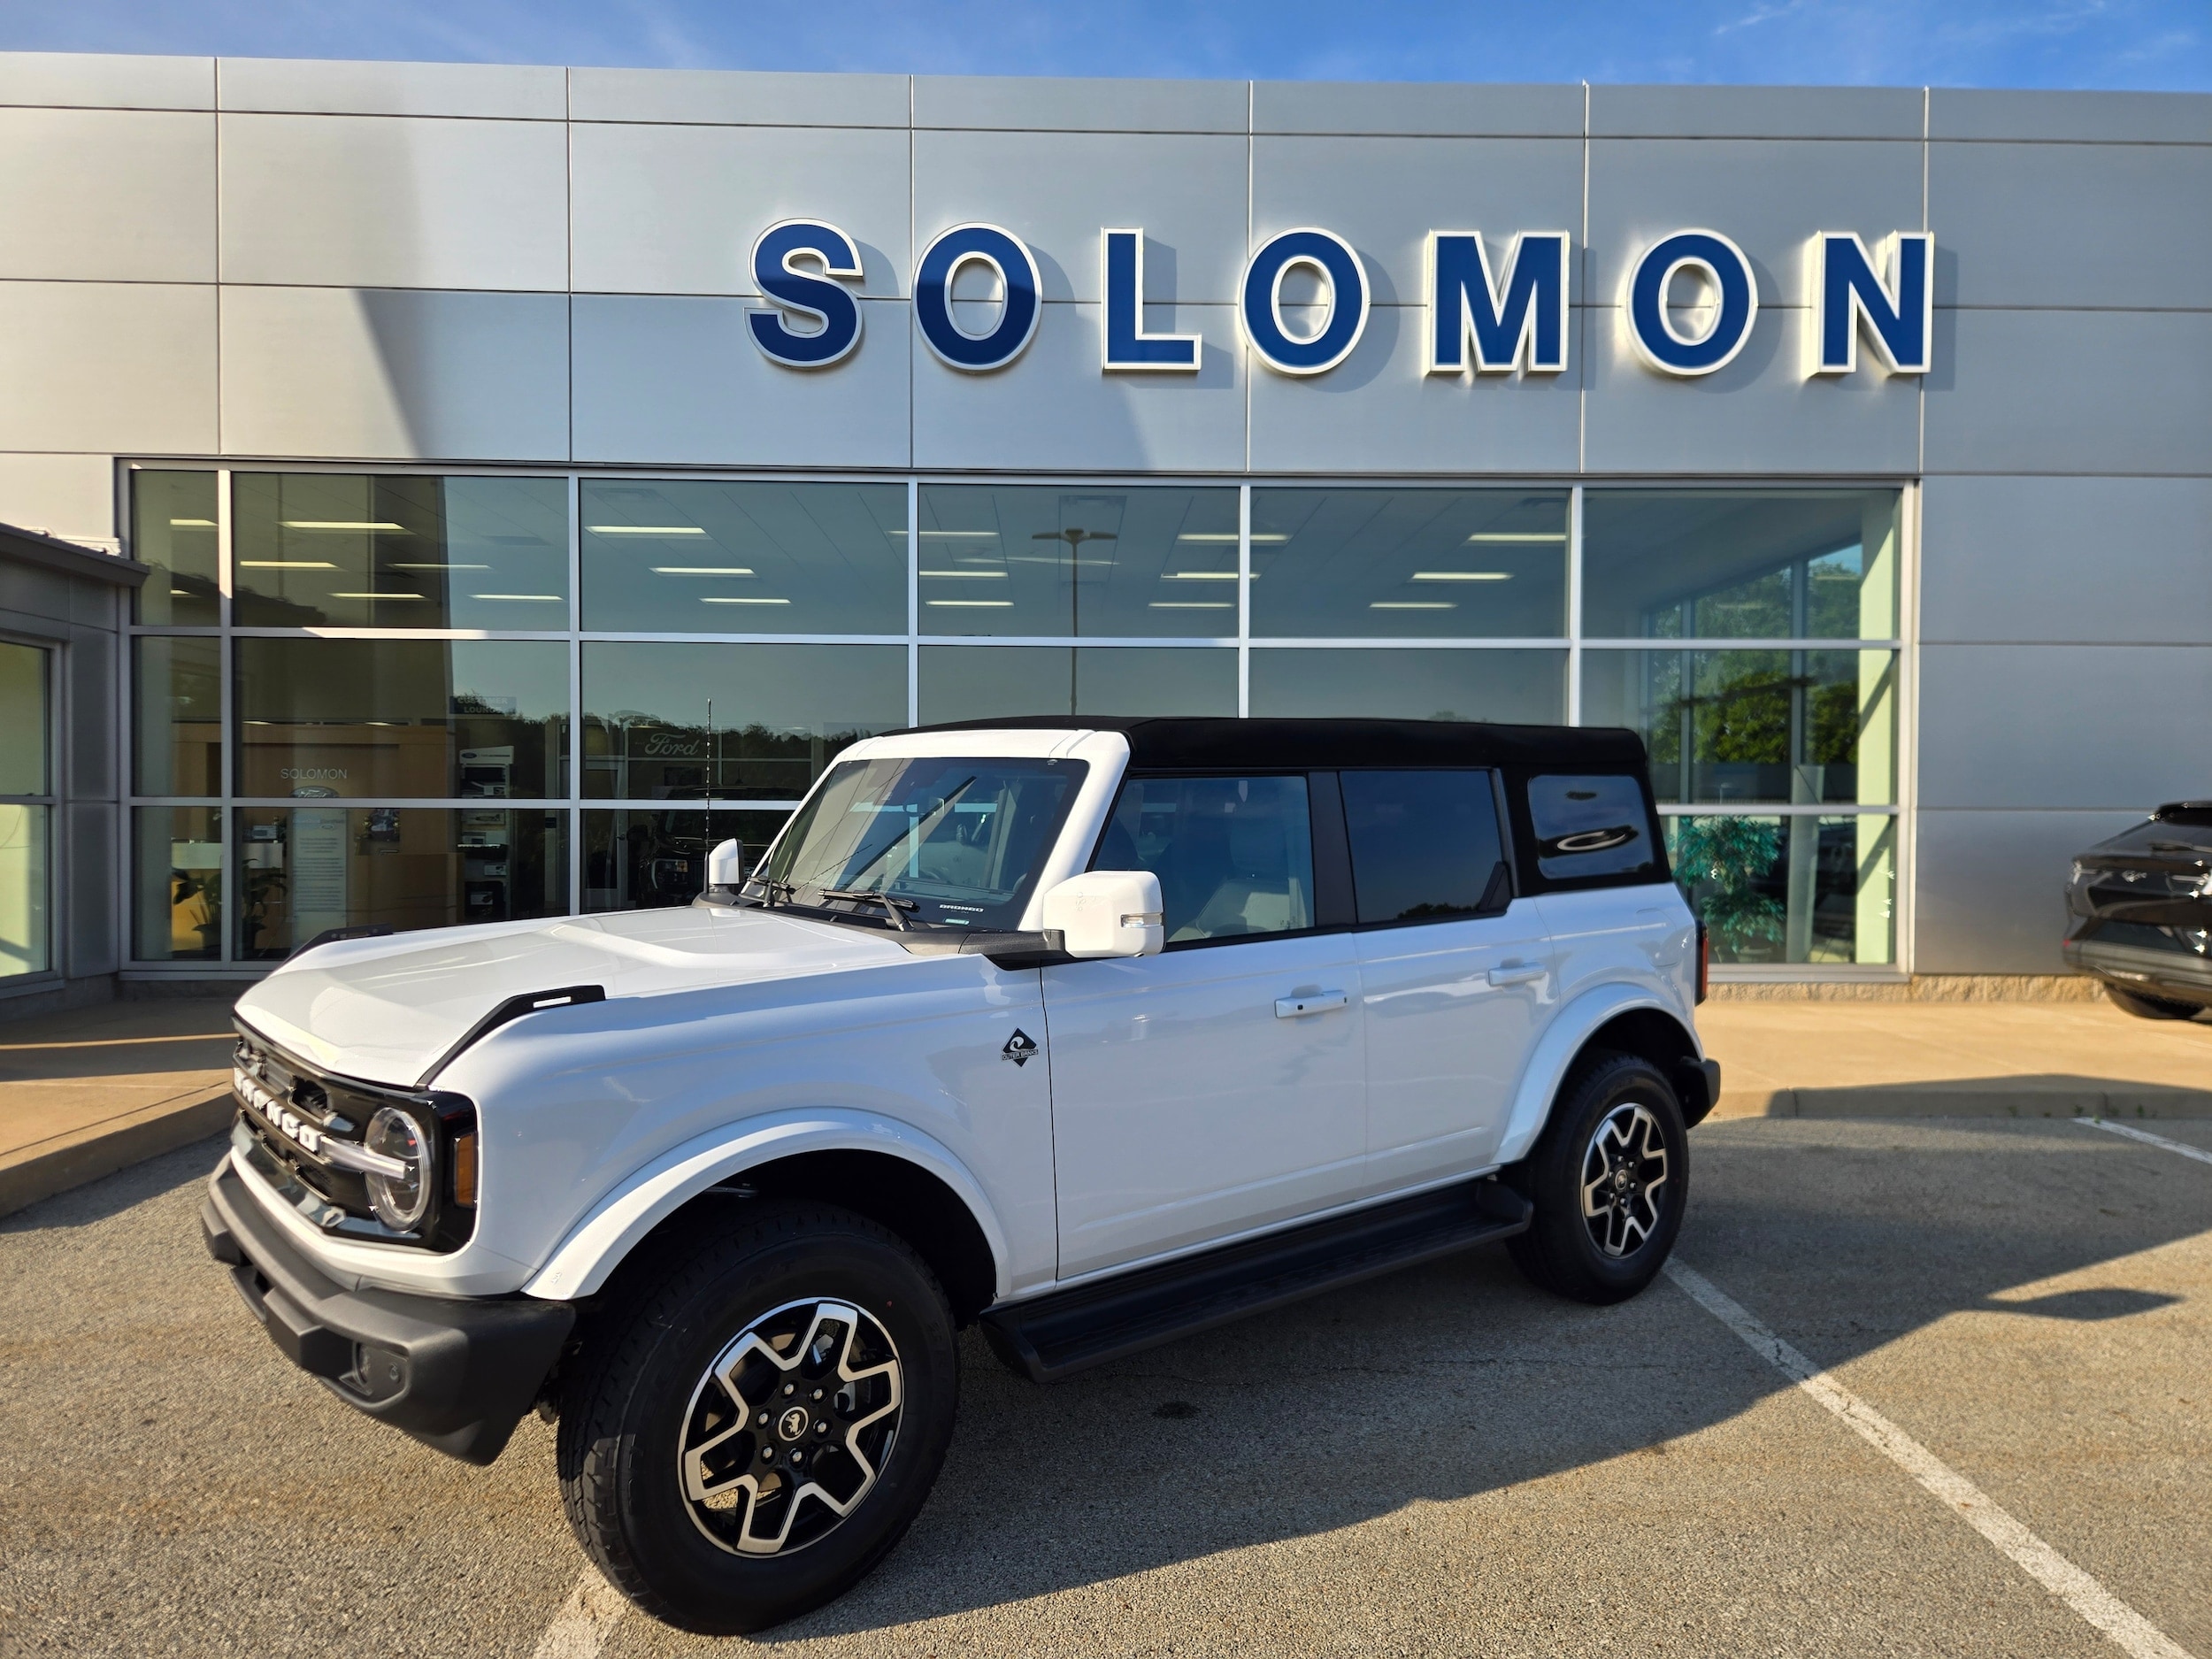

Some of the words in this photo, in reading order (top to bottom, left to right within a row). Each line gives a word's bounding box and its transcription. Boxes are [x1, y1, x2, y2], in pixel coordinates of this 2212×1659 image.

[748, 218, 1934, 376] SOLOMON
[644, 733, 700, 756] Ford
[280, 768, 348, 780] SOLOMON
[939, 903, 985, 913] BRONCO
